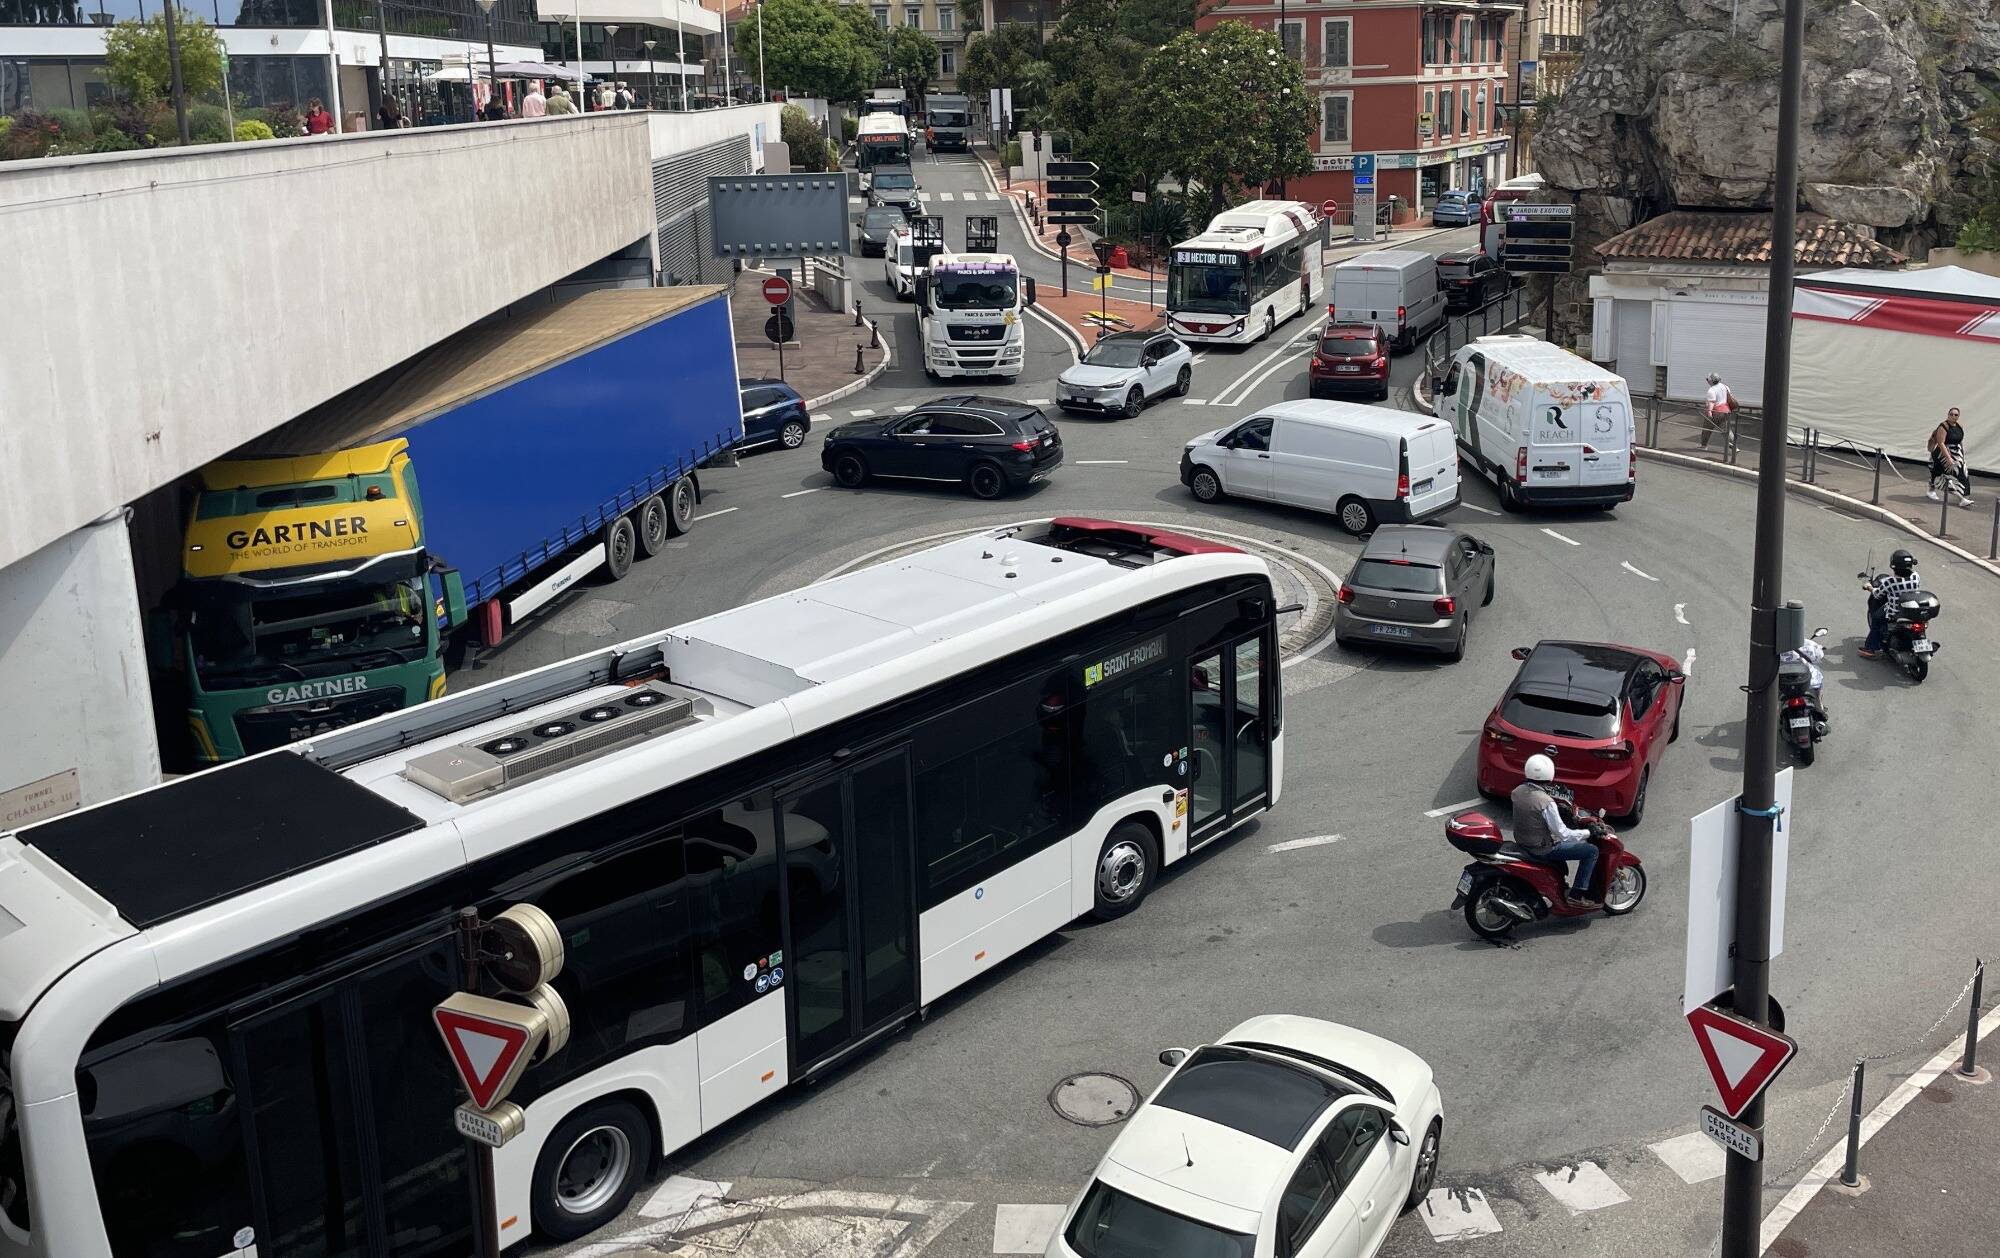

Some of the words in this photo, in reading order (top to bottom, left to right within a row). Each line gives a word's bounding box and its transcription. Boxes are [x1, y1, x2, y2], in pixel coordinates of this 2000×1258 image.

[1359, 157, 1368, 169] P
[1190, 252, 1216, 264] HECTOR
[1219, 253, 1237, 264] OTTO
[964, 328, 990, 336] MAN
[1539, 430, 1574, 441] REACH
[227, 516, 368, 549] GARTNER
[230, 552, 250, 560] THE
[253, 545, 291, 559] WORLD
[294, 542, 308, 552] OF
[312, 536, 368, 550] TRANSPORT
[1104, 640, 1162, 677] SAINT-ROMAN
[267, 675, 368, 704] GARTNER
[24, 786, 53, 802] TUNNEL
[6, 799, 55, 821] CHARLES
[61, 791, 73, 801] III
[461, 1122, 497, 1142] PASSAGE
[488, 1124, 498, 1135] LE
[1707, 1115, 1736, 1137] CÉDEZ
[1741, 1133, 1752, 1146] LE
[1708, 1125, 1751, 1155] PASSAGE
